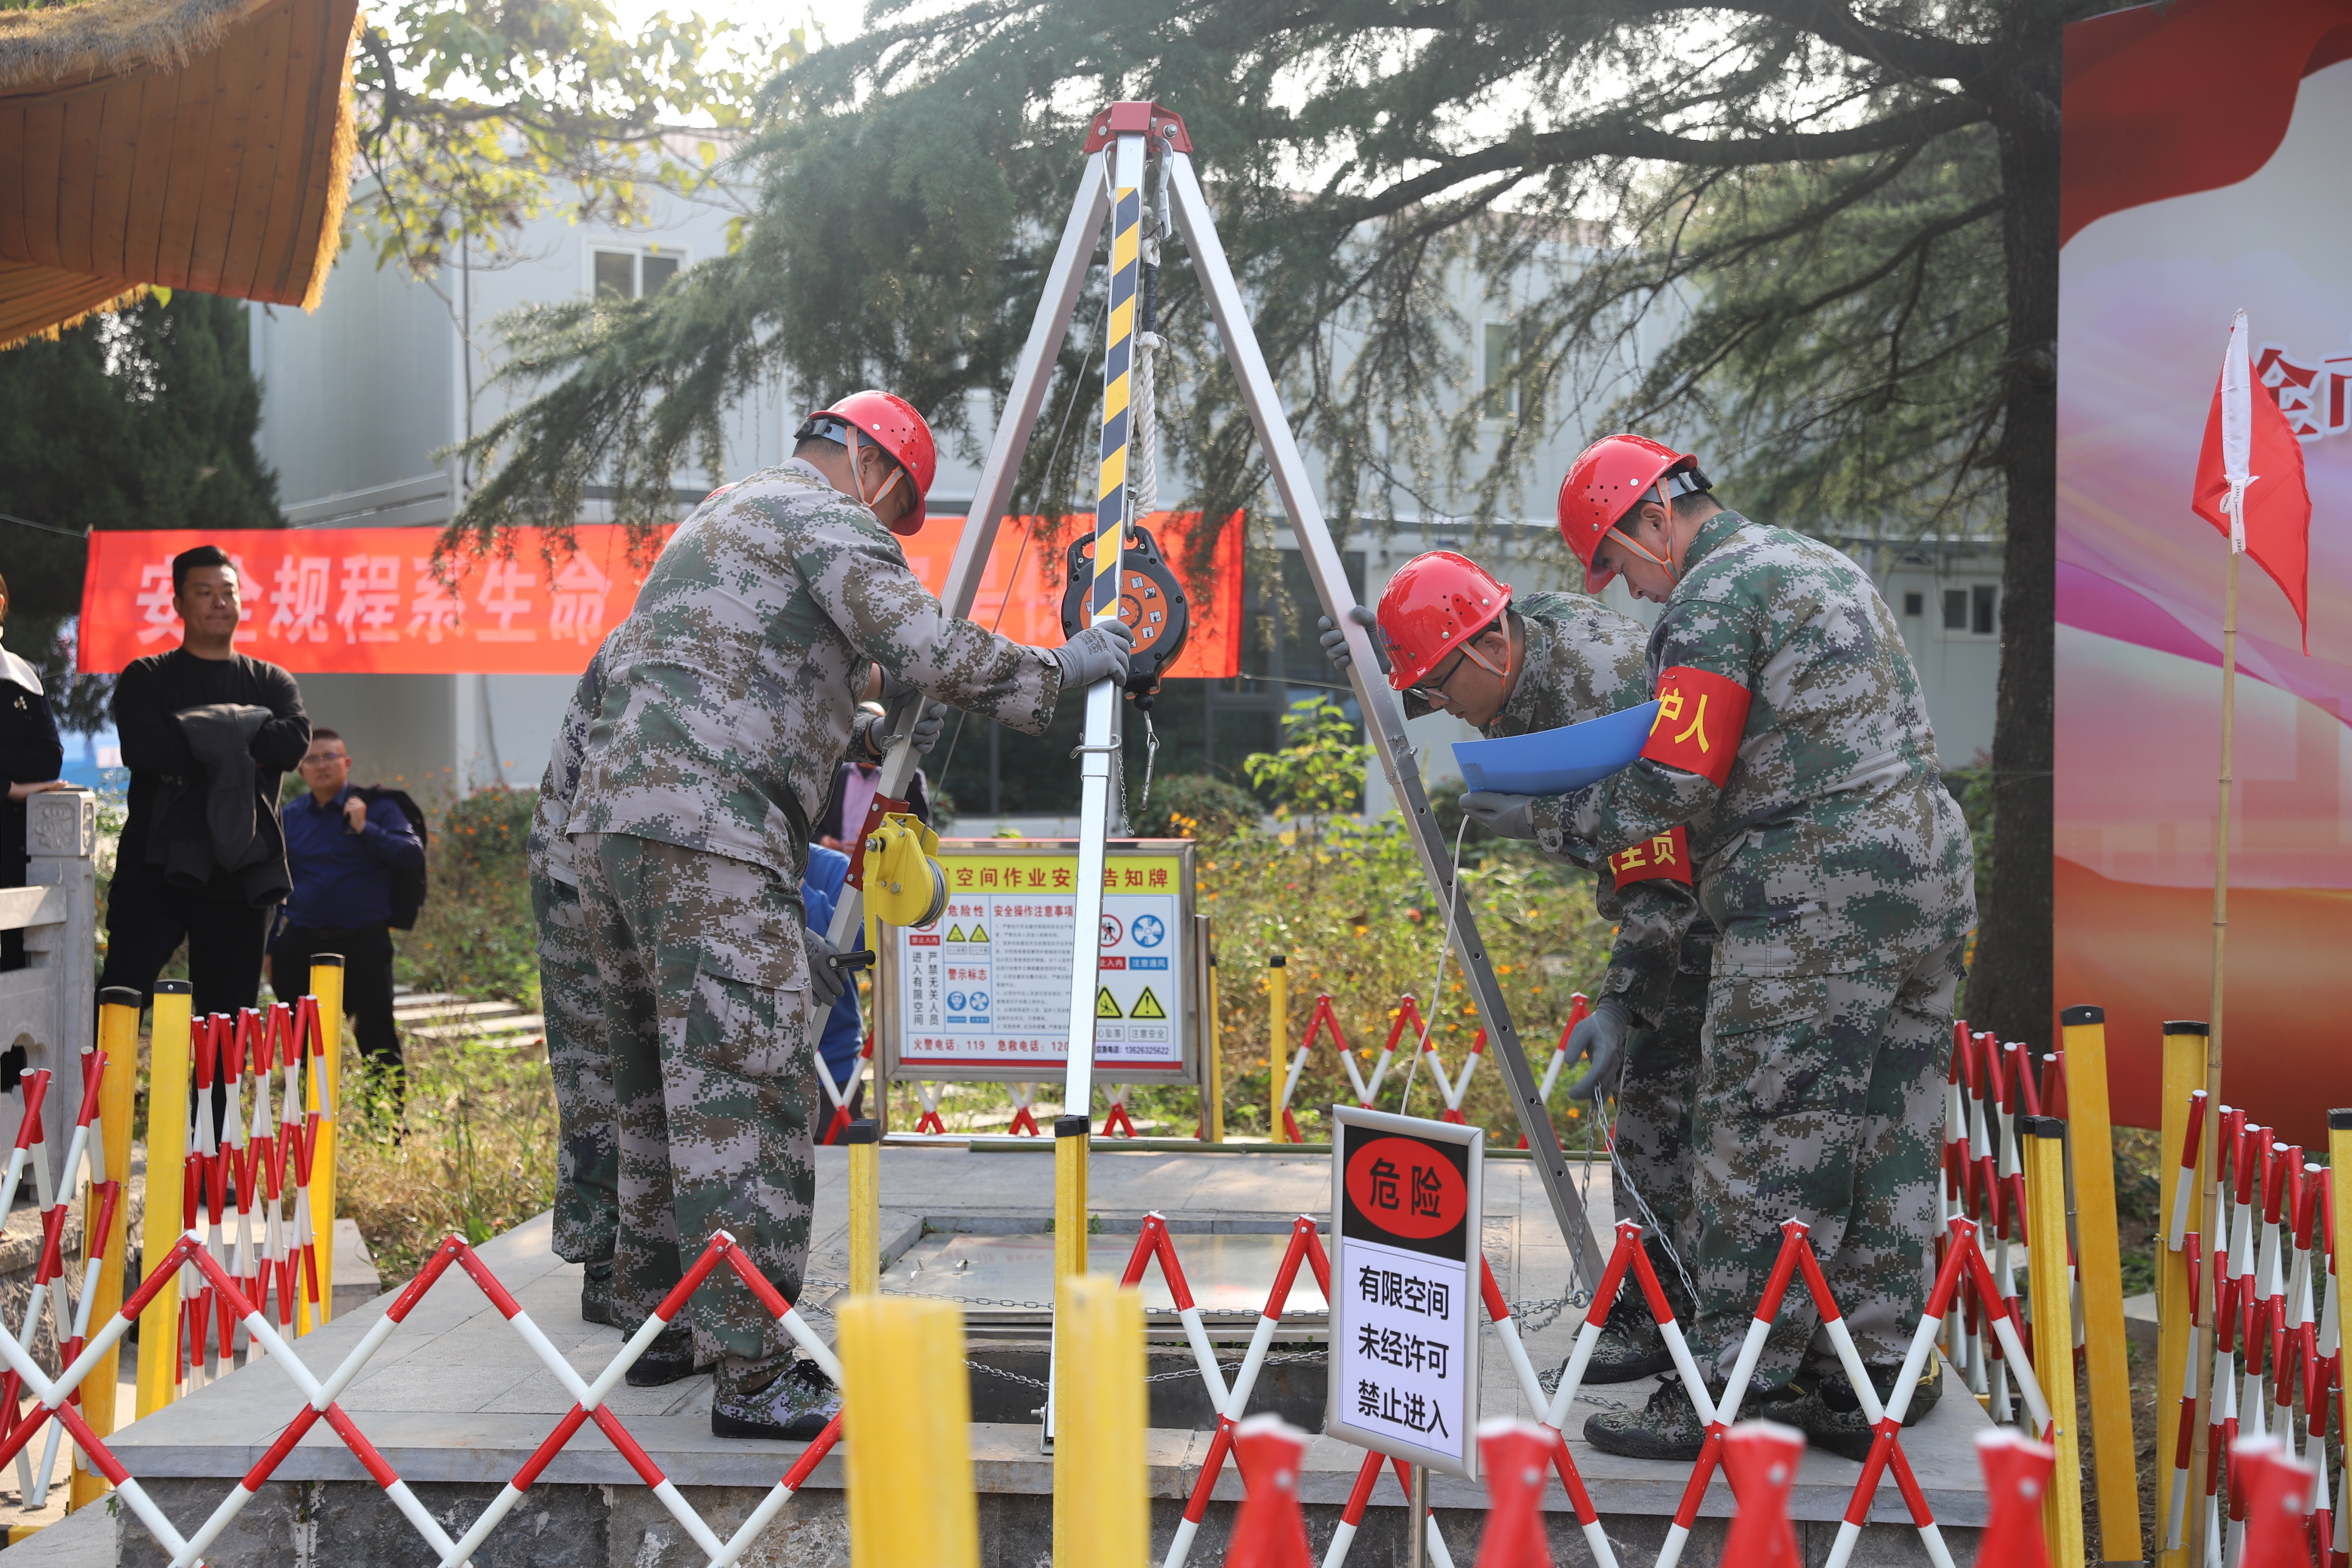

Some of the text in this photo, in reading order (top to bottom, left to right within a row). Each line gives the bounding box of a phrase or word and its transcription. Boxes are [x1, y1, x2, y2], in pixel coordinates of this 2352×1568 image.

[1649, 687, 1710, 754] 护人
[945, 868, 1169, 888] 空间作业安告知牌
[948, 905, 985, 917] 危险性
[994, 905, 1074, 917] 安全操作注意事项
[1100, 957, 1123, 968] 止入内
[1132, 959, 1166, 968] 注意通风
[948, 969, 987, 981] 警示标志
[912, 951, 924, 1026] 进入有限空间
[928, 951, 939, 1026] 严禁无关人员
[1097, 1028, 1122, 1039] 心坠落
[1132, 1029, 1165, 1039] 注意安全
[1369, 1157, 1442, 1219] 危险
[1358, 1265, 1449, 1321] 有限空间
[1358, 1323, 1449, 1380] 未经许可
[1358, 1379, 1449, 1439] 禁止进入
